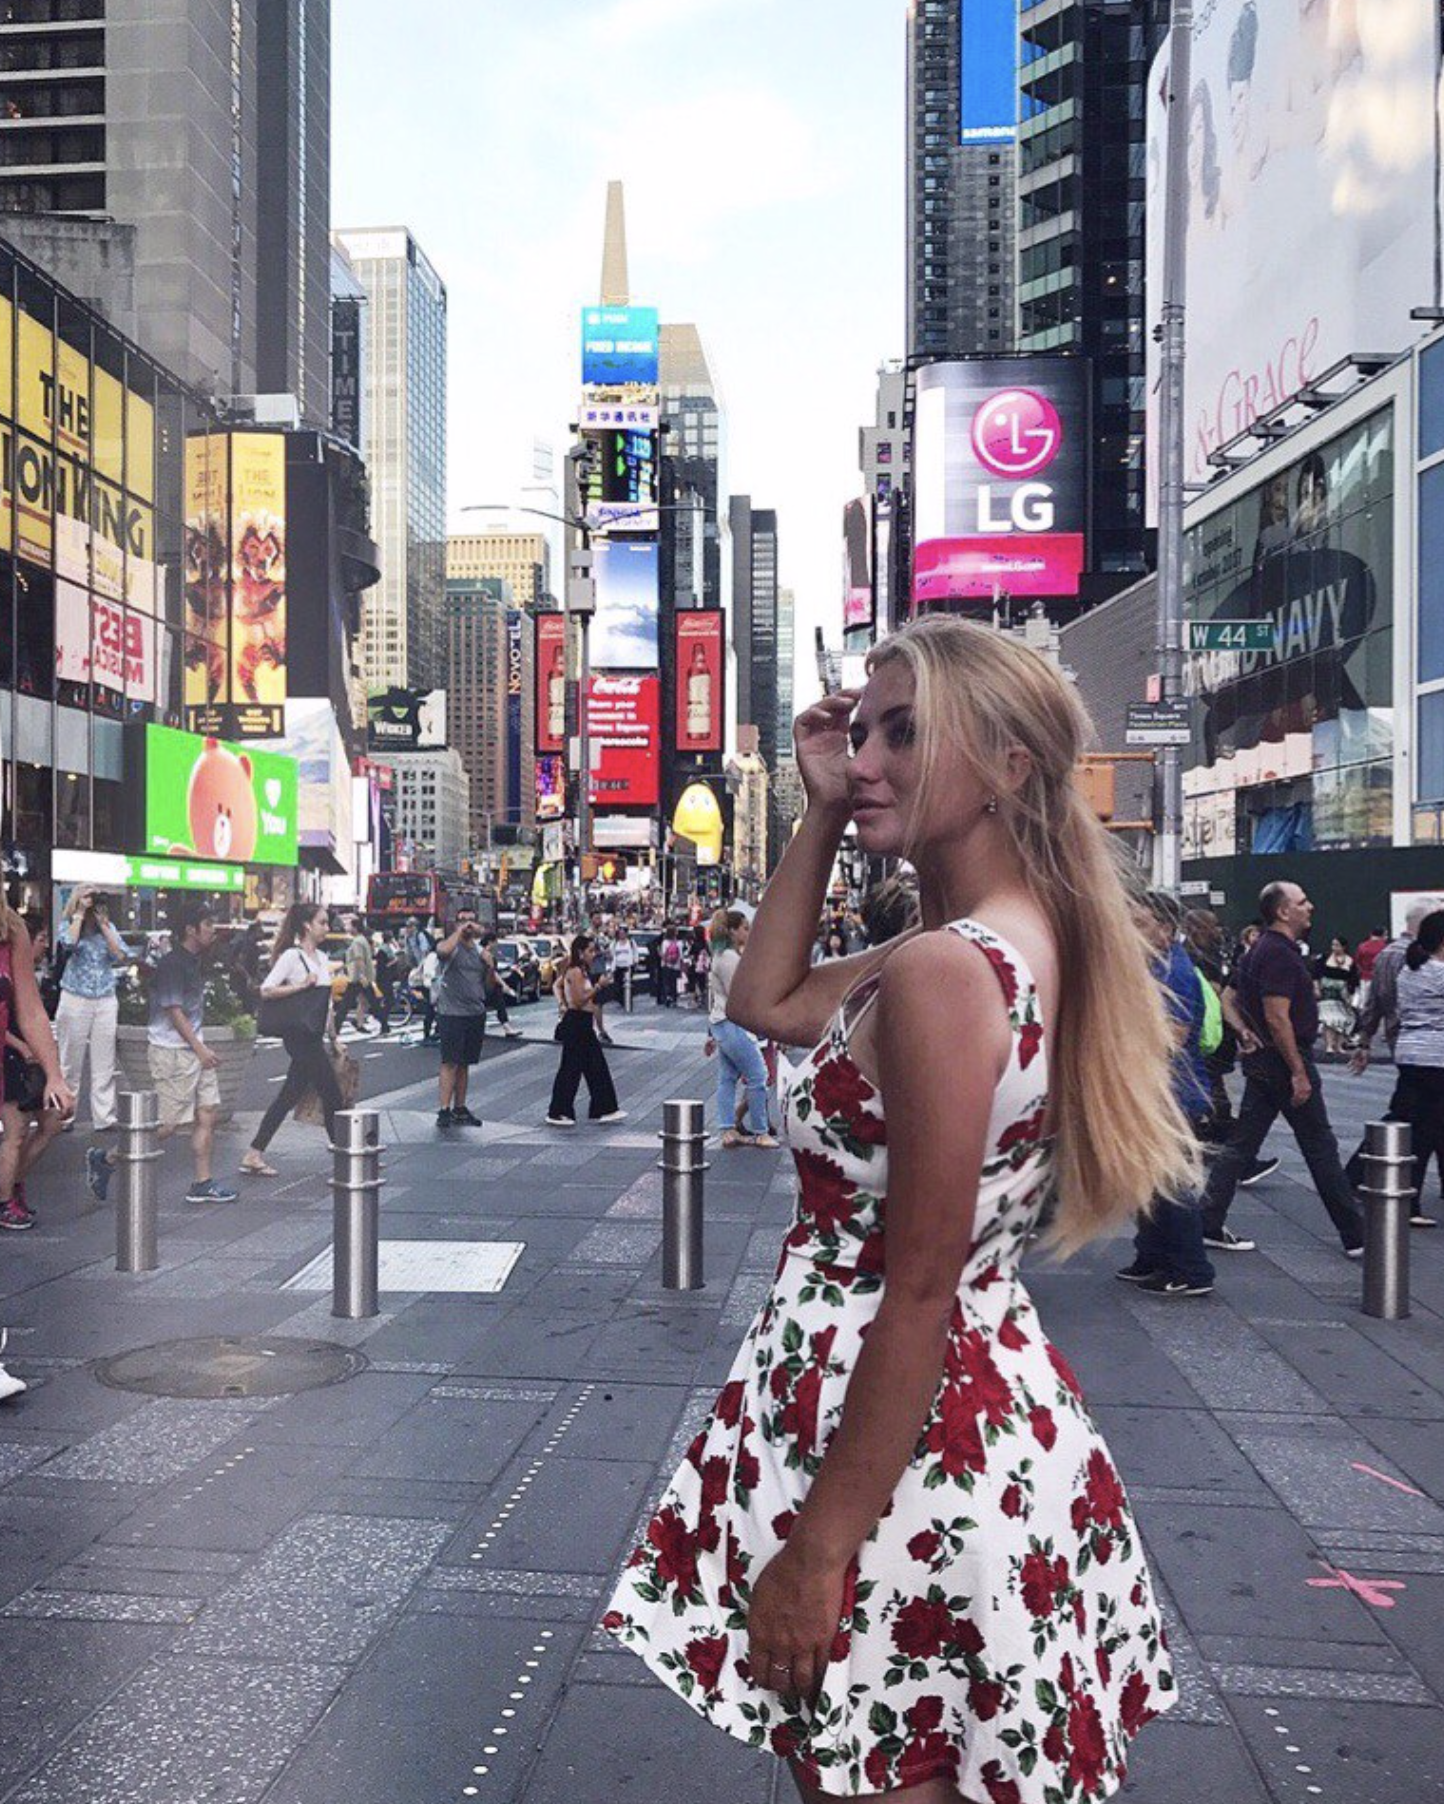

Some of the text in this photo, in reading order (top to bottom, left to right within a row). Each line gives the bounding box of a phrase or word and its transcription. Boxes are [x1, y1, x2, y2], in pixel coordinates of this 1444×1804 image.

[39, 369, 89, 442] THE
[977, 482, 1054, 533] LG
[508, 618, 521, 695] NOVOTEL
[1192, 625, 1270, 648] W 44 ST
